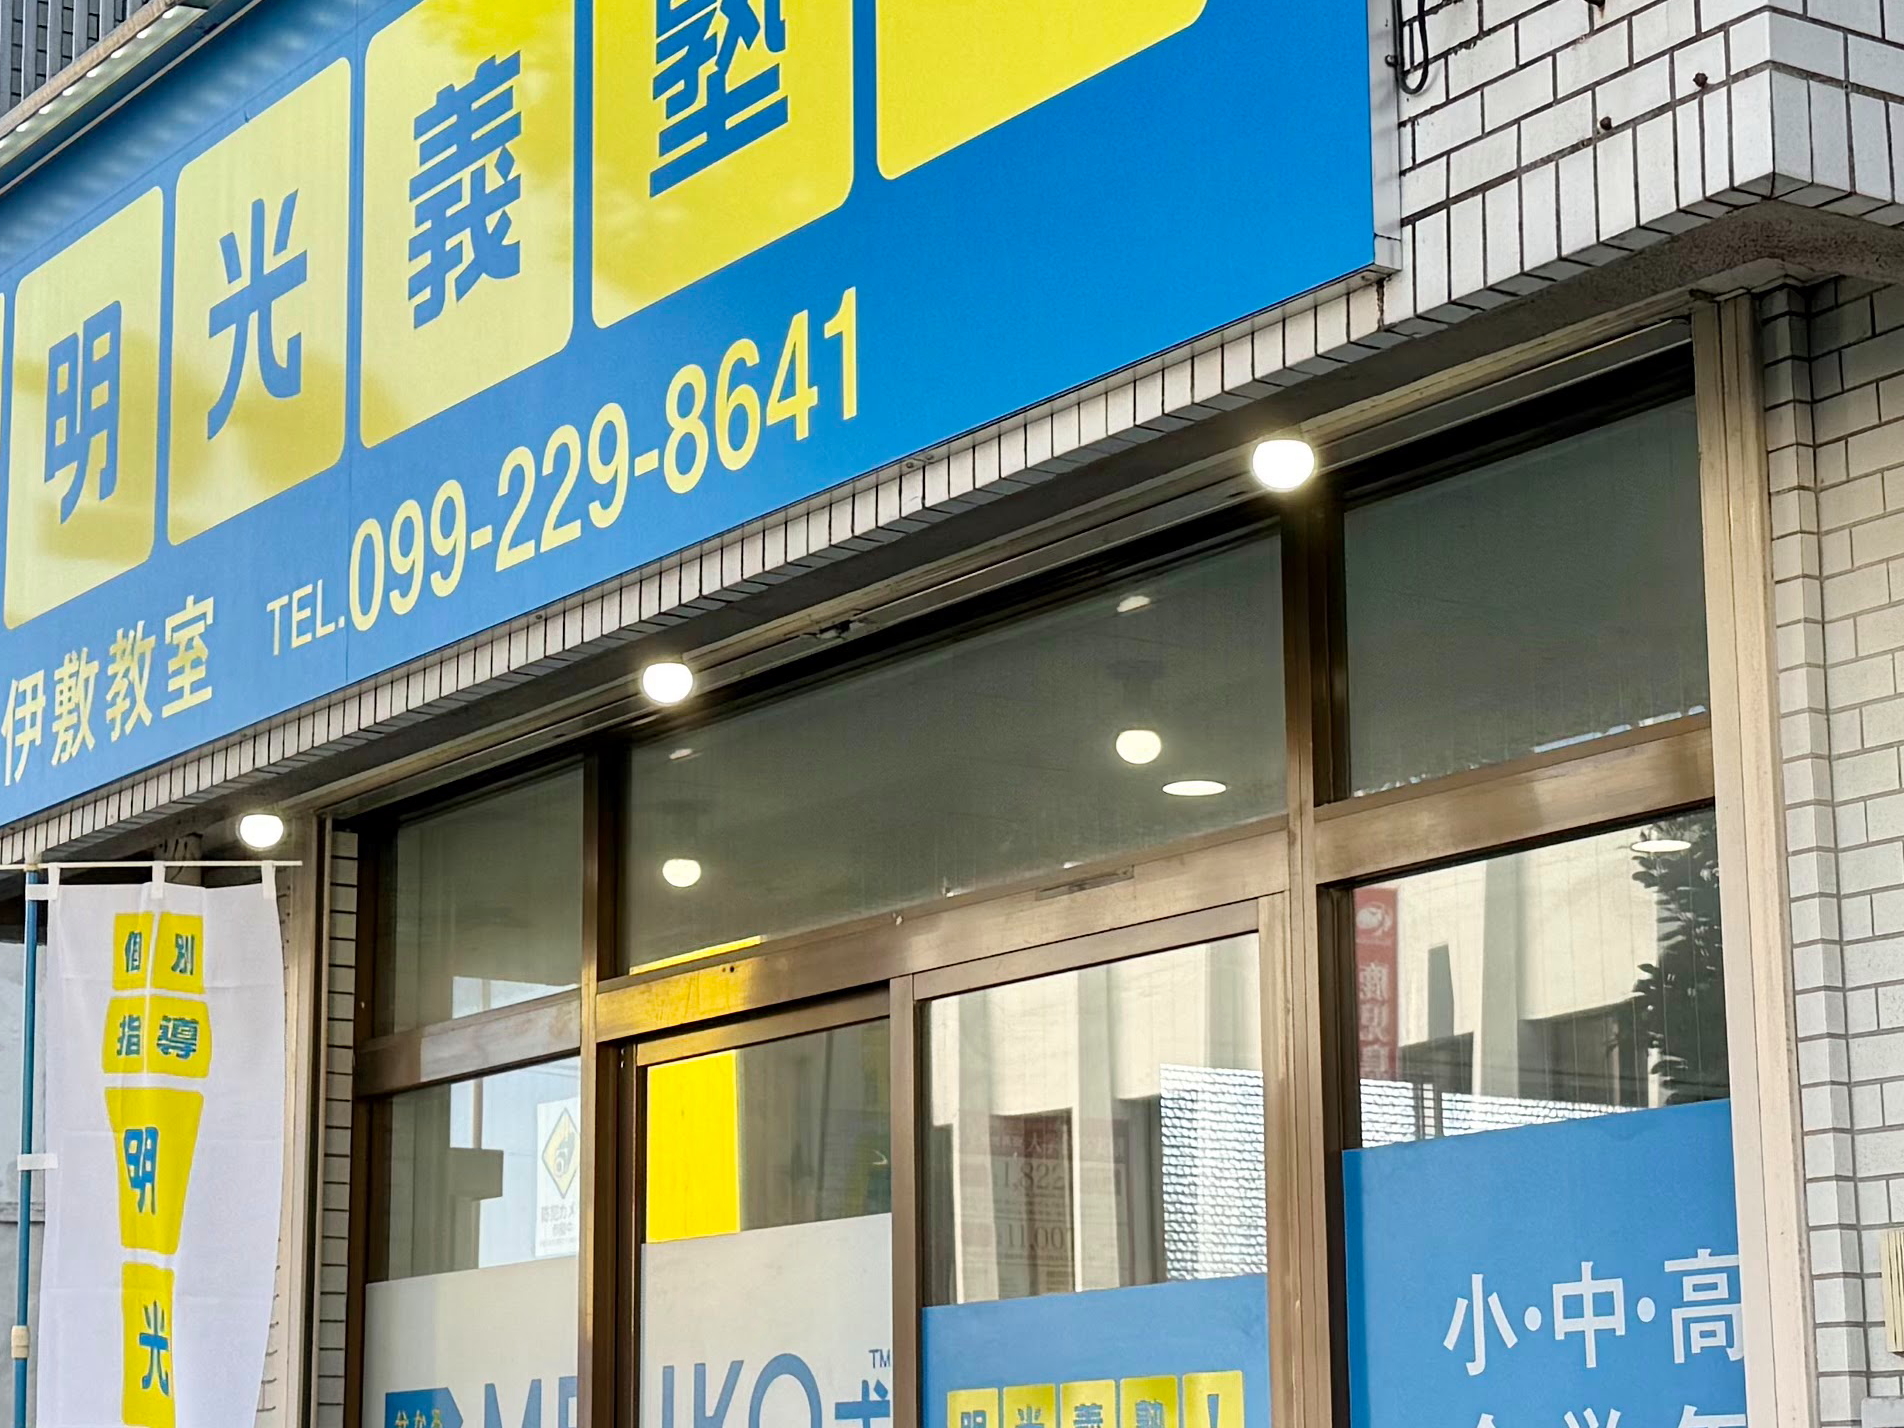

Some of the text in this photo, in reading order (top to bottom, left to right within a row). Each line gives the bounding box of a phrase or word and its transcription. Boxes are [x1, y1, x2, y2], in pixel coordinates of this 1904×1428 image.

[349, 288, 863, 635] 099-229-8641
[1, 595, 214, 785] 伊敷教室
[125, 930, 195, 976] 個別
[116, 1014, 200, 1060] 指導
[1443, 1248, 1744, 1376] 小・中・高
